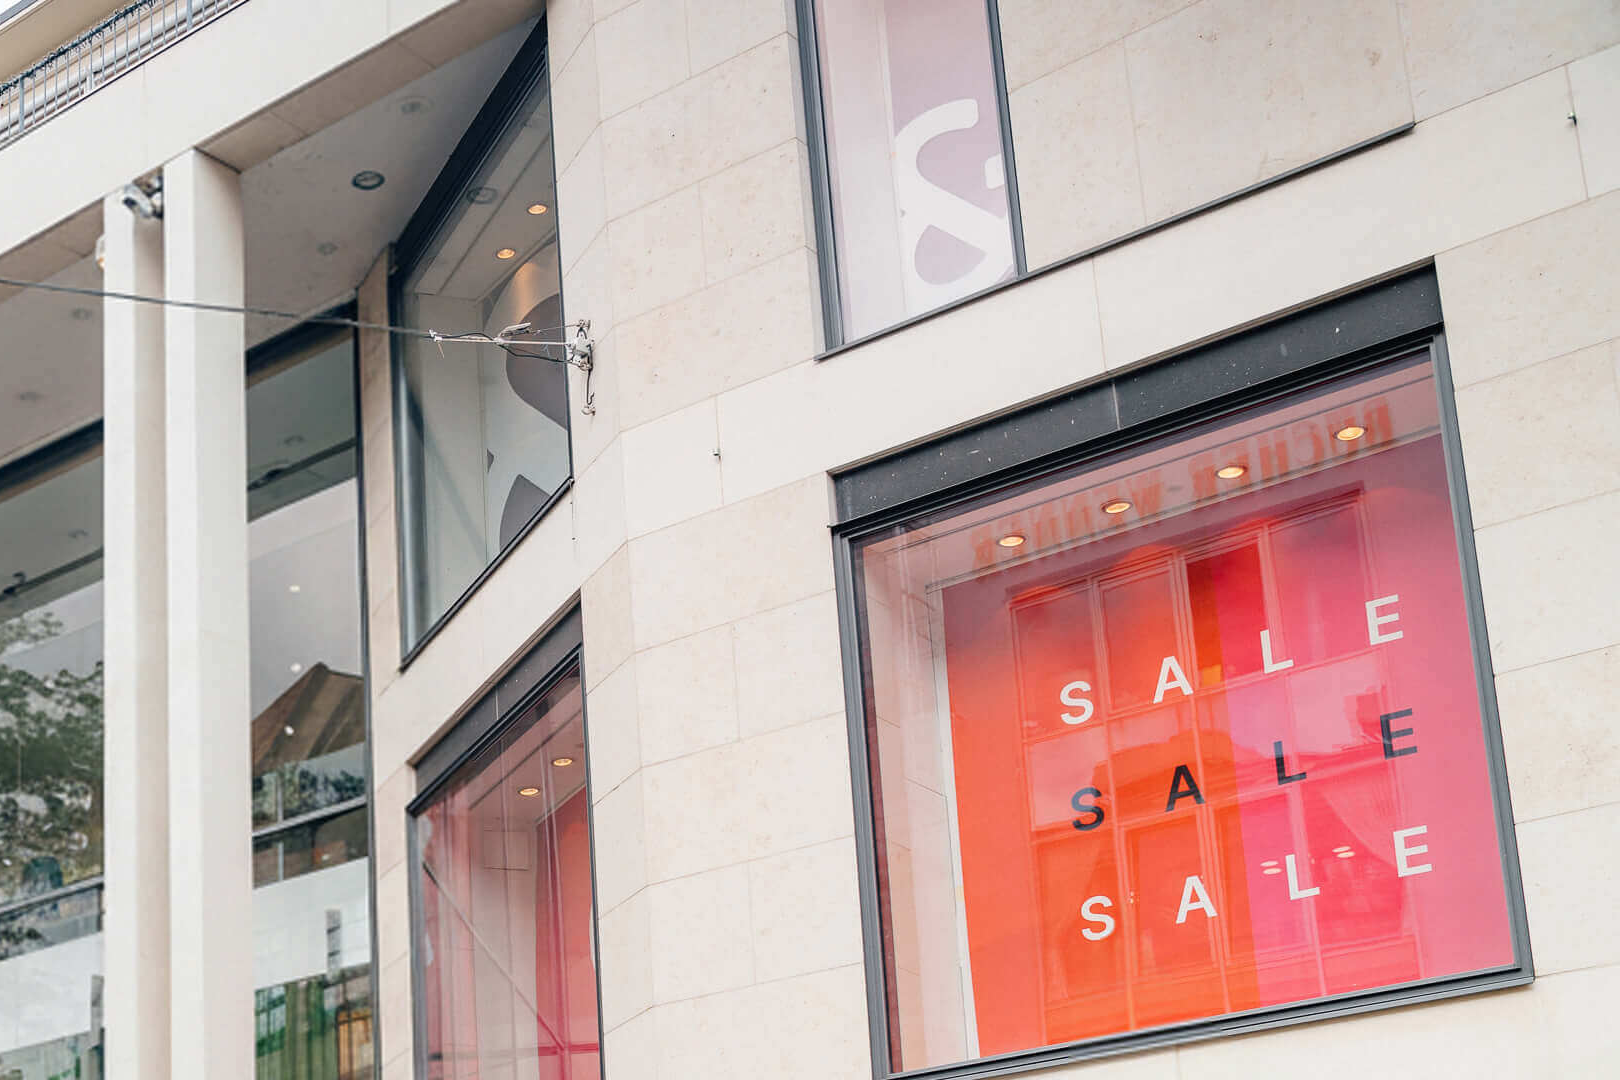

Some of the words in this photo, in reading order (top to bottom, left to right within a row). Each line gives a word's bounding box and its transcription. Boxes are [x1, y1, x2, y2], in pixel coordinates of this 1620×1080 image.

[1059, 594, 1404, 725] SALE
[1070, 708, 1418, 831] SALE
[1080, 825, 1433, 941] SALE
